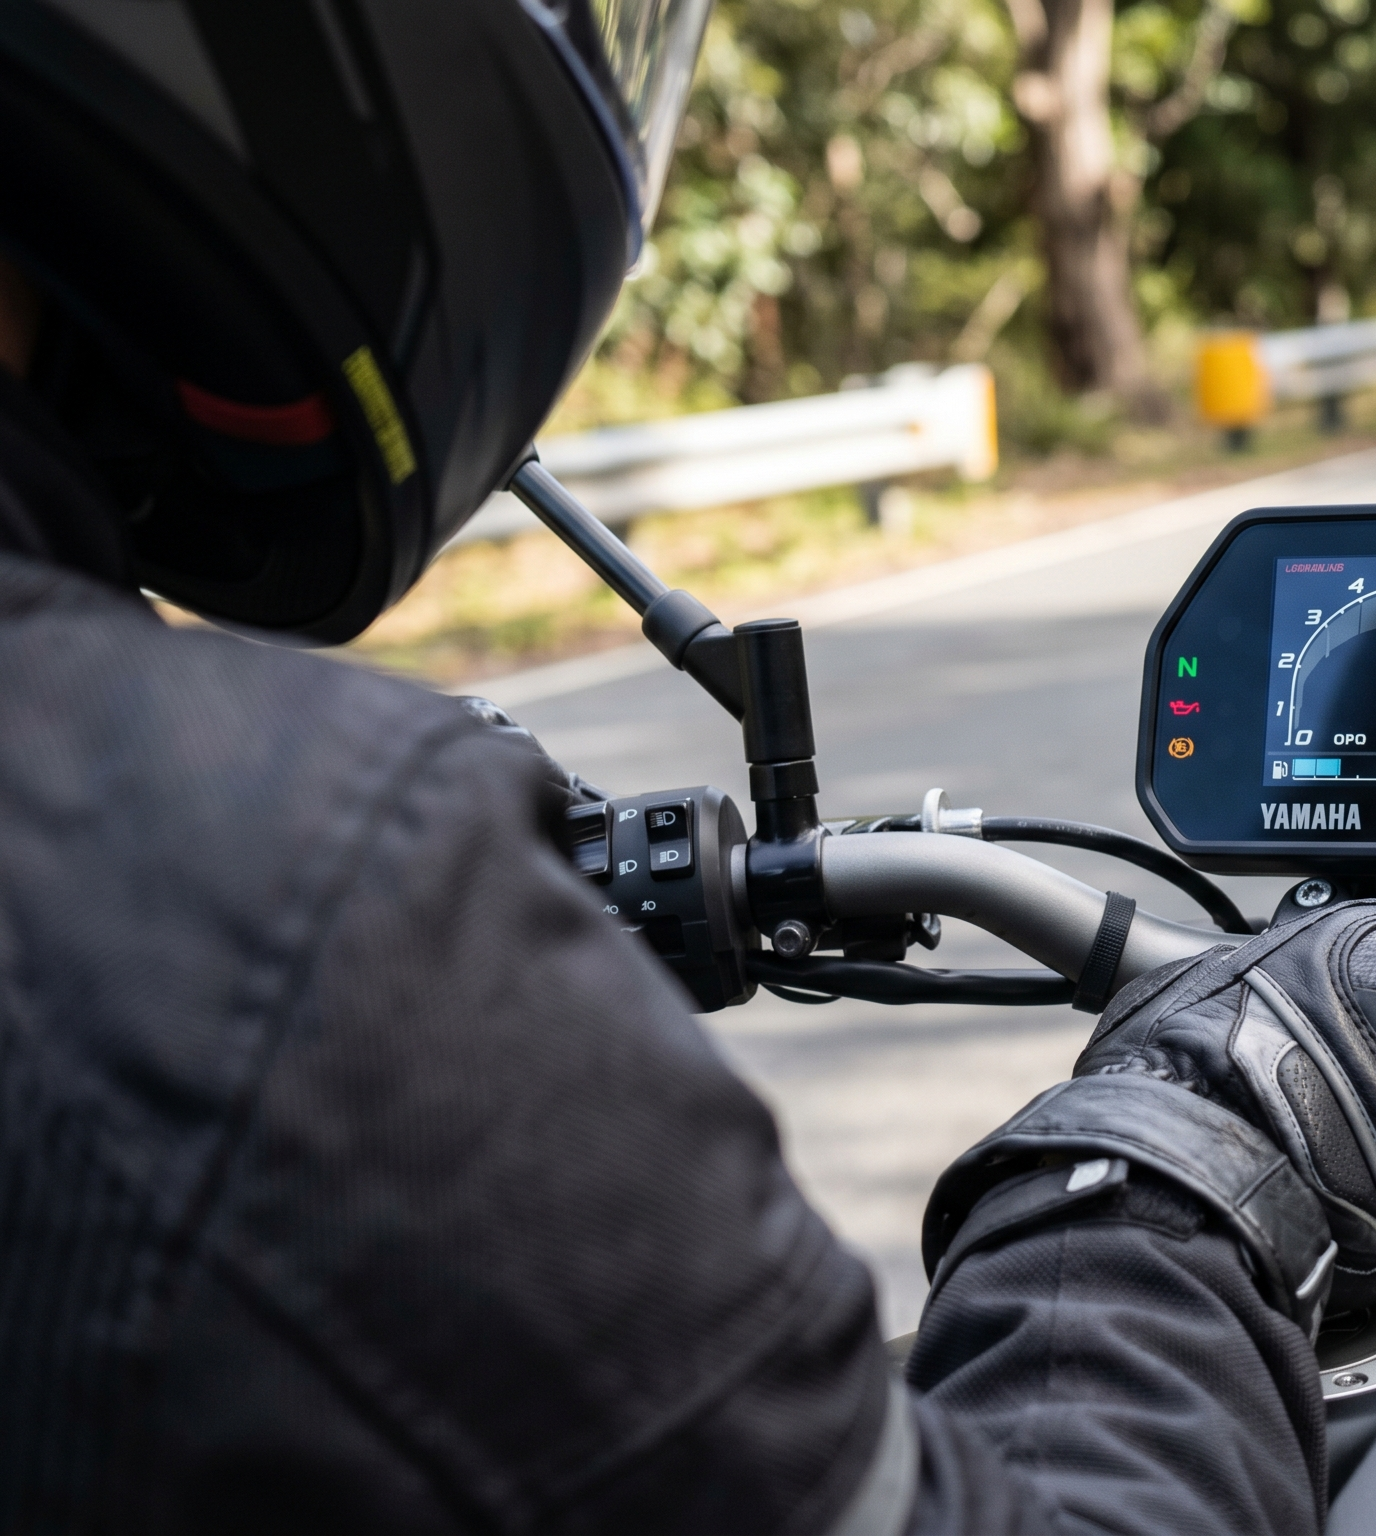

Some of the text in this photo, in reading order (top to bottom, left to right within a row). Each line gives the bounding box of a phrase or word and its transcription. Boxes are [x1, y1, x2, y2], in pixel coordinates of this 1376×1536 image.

[1347, 577, 1365, 594] 4
[1304, 609, 1323, 626] 3
[1178, 656, 1198, 678] N
[1277, 652, 1296, 669] 2
[1276, 700, 1285, 717] 1
[1294, 729, 1314, 746] 0
[1260, 802, 1362, 830] YAMAHA
